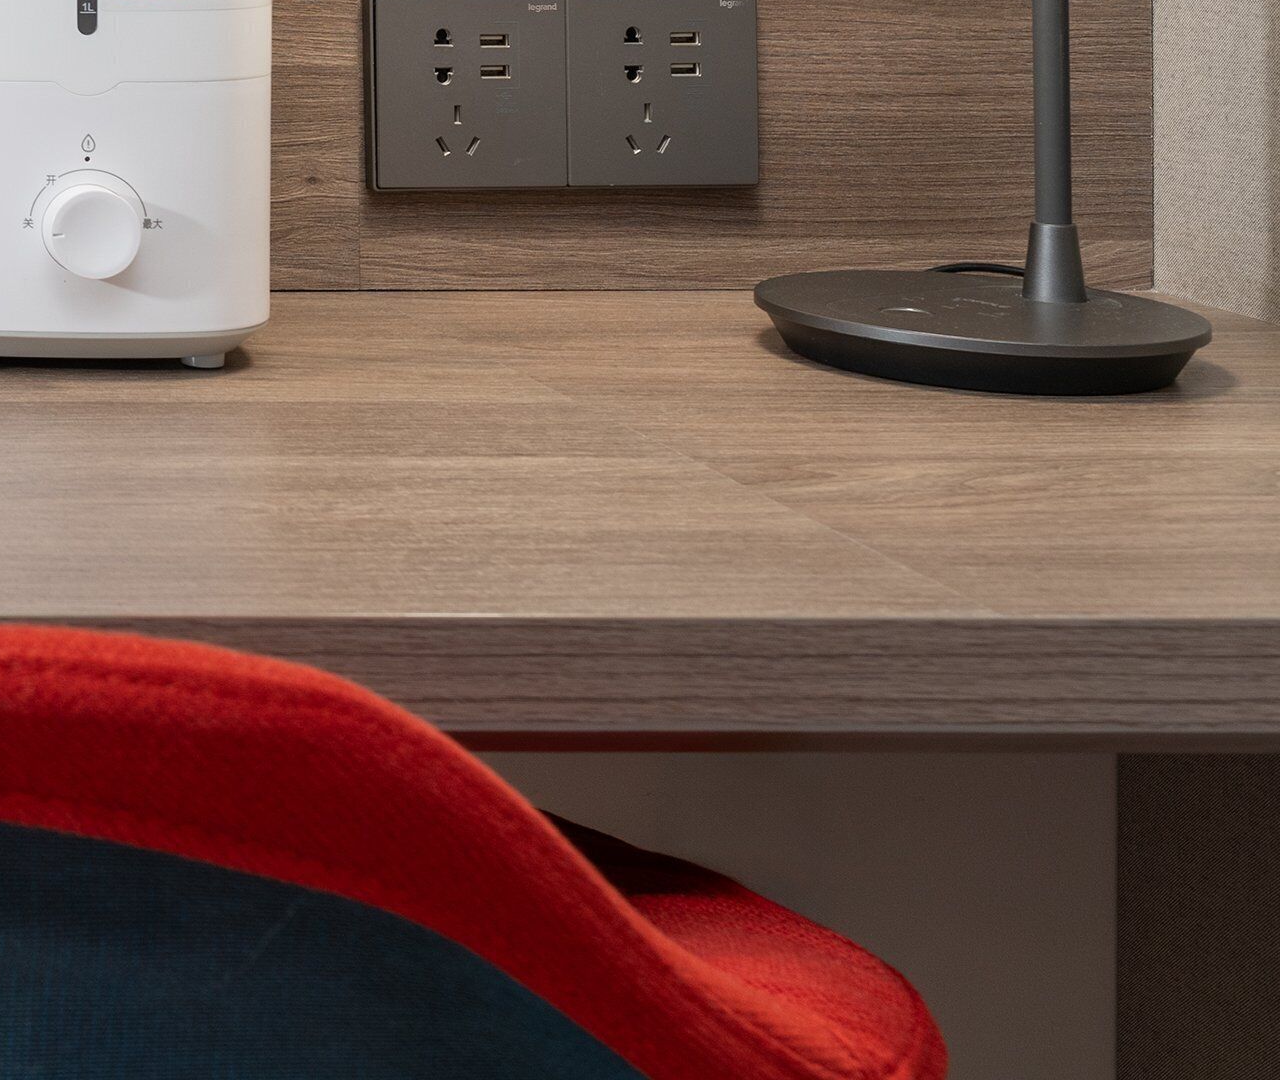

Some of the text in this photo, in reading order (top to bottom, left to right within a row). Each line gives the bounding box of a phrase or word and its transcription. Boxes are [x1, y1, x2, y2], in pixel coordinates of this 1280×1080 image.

[81, 2, 94, 12] 1L
[528, 3, 557, 12] legrand
[46, 174, 57, 186] 开
[23, 218, 34, 229] 关
[143, 218, 163, 230] 最大
